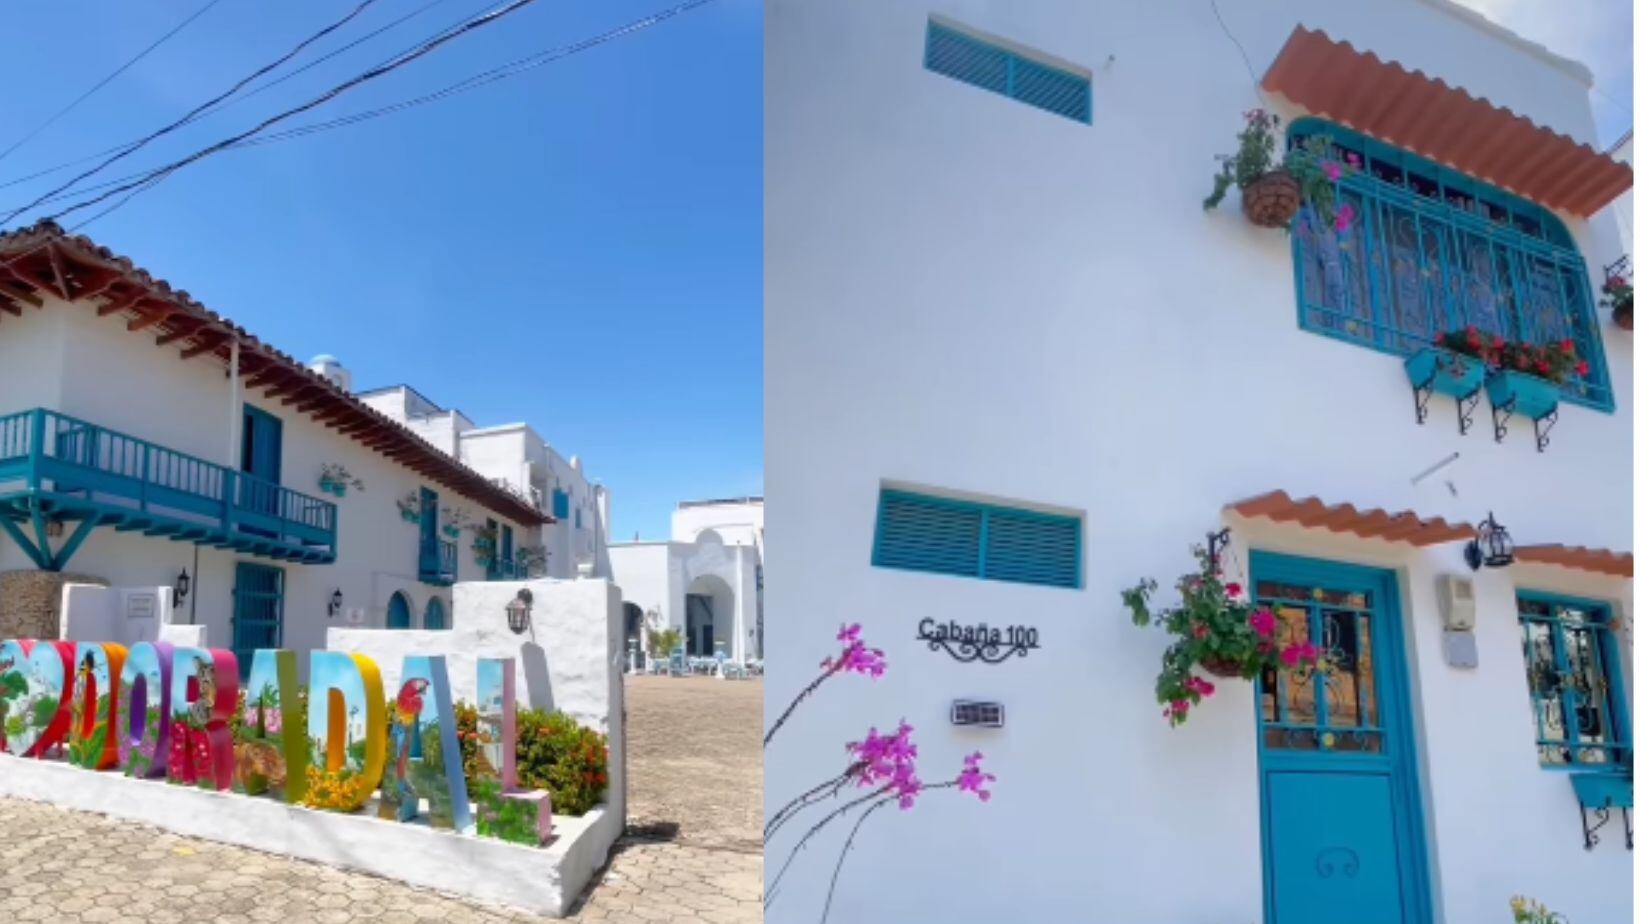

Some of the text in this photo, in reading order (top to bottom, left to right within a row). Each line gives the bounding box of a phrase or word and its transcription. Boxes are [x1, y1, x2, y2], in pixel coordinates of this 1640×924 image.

[918, 617, 1039, 648] Cabaña 100
[70, 641, 552, 846] DORADAL
